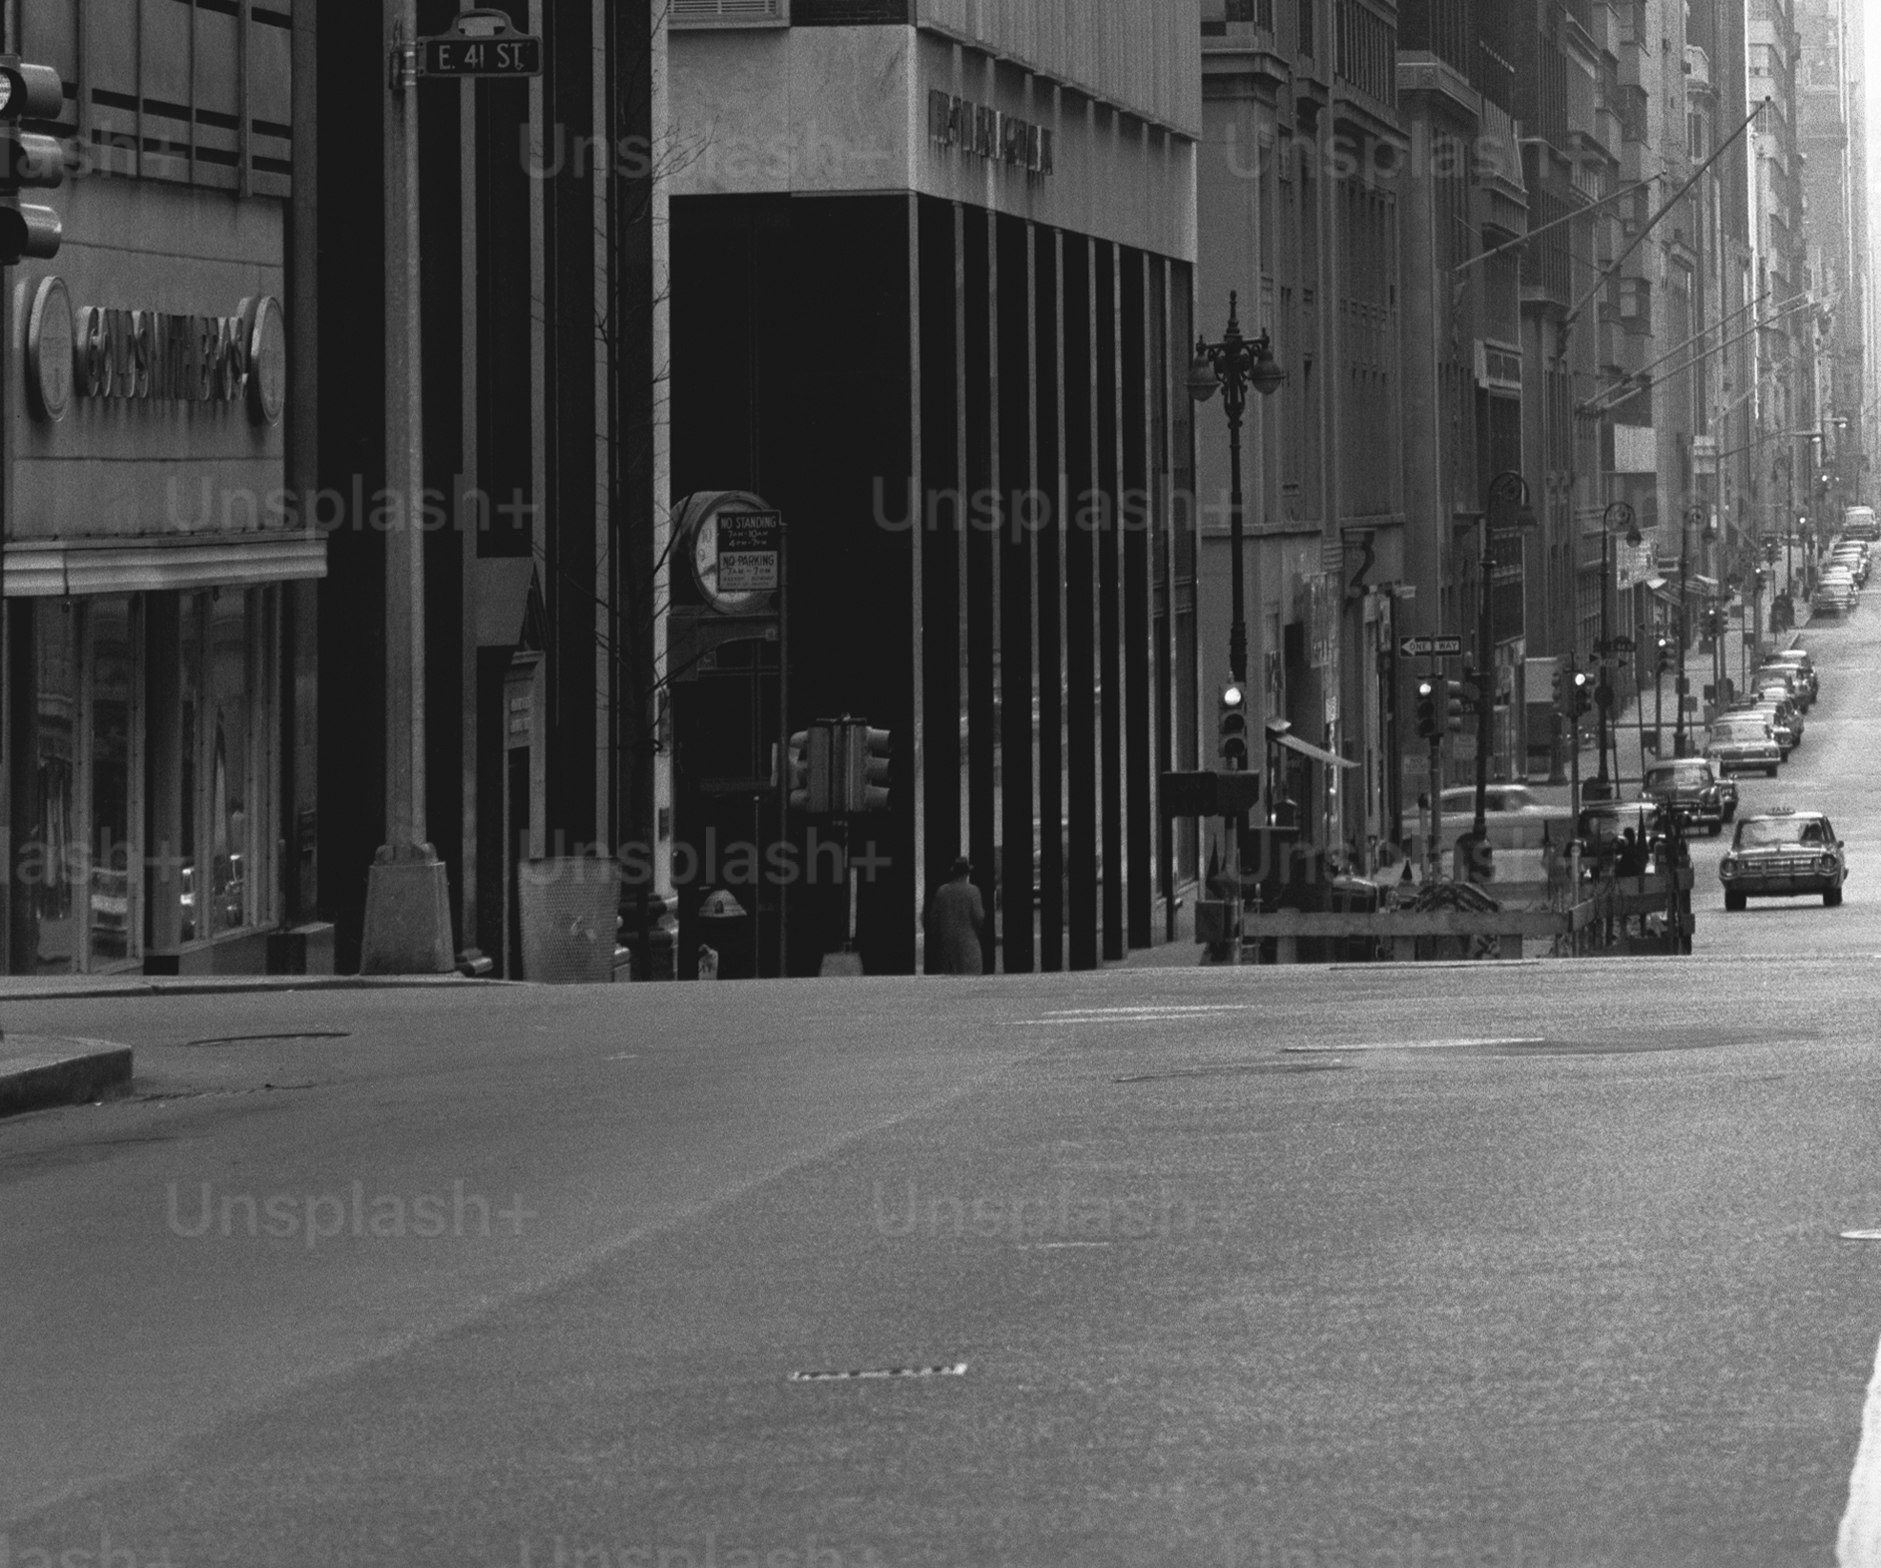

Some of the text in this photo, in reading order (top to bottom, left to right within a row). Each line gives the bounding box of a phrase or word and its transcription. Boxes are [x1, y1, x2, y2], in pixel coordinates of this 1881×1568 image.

[438, 45, 456, 70] E.
[464, 44, 485, 69] 41
[720, 515, 776, 529] NO STANDING
[723, 554, 774, 566] NO PARKING
[1409, 641, 1457, 652] ONE WAY
